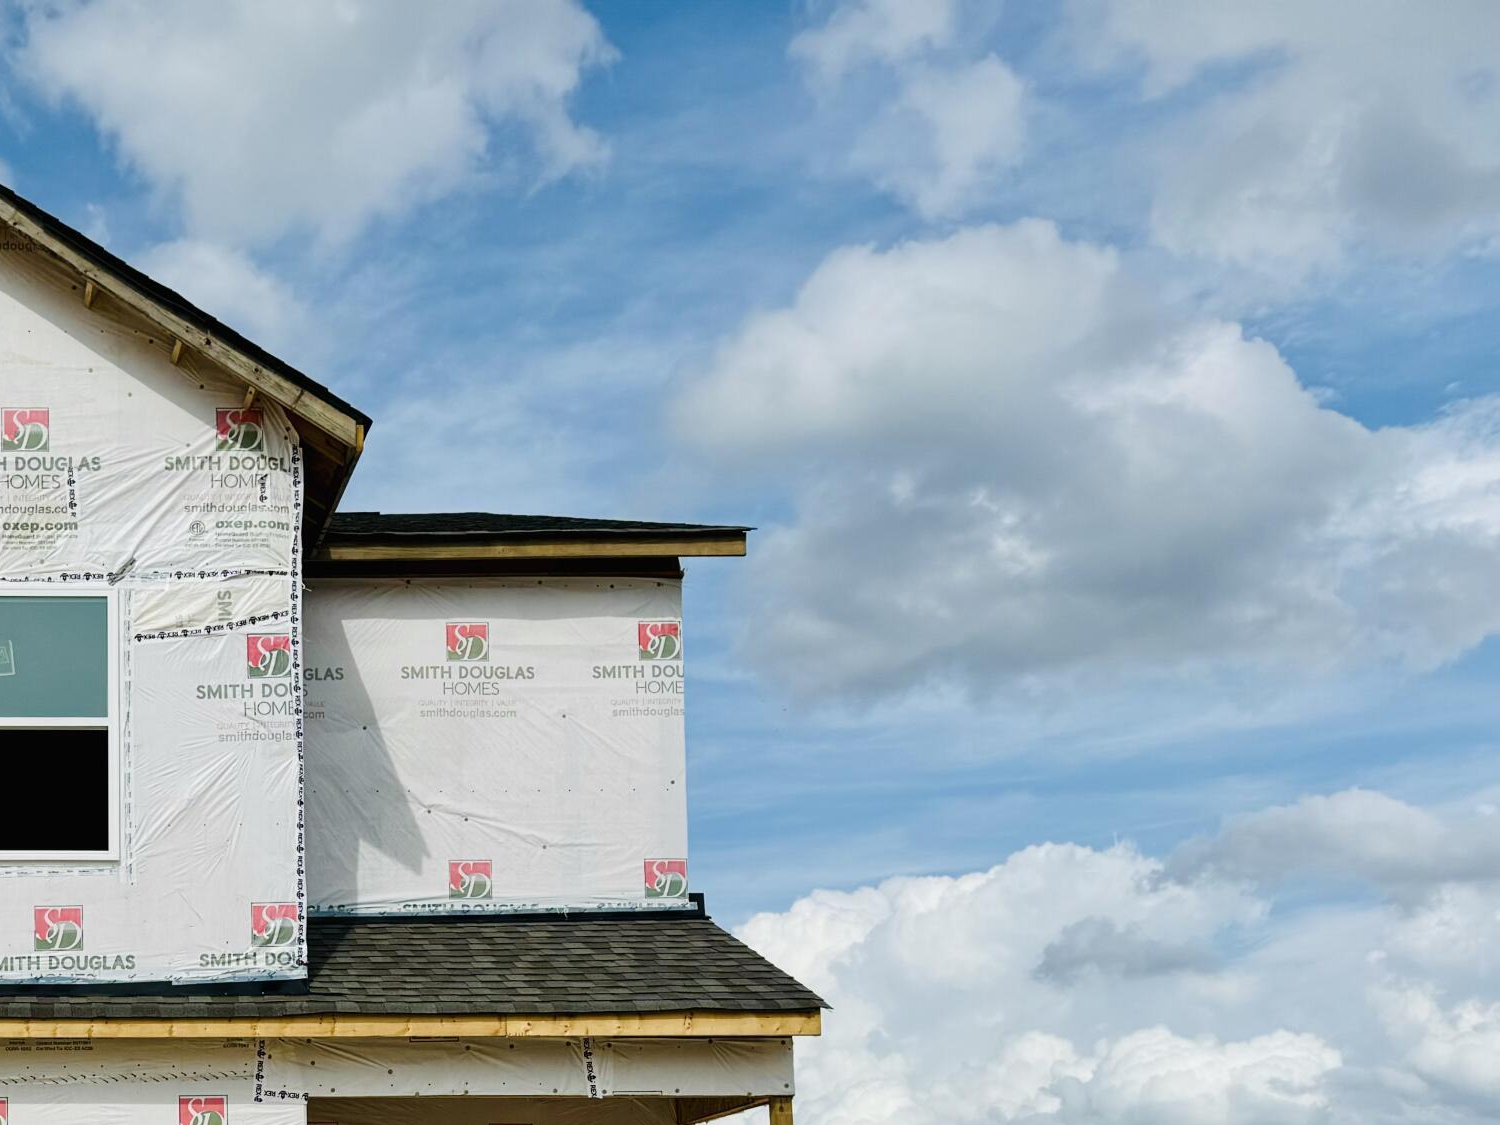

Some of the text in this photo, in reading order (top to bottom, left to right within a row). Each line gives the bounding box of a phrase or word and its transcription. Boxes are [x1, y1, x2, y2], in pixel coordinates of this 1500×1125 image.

[14, 456, 101, 472] DOUGLAS
[164, 456, 221, 471] SMITH
[184, 502, 290, 514] smithdouglas.com
[2, 521, 78, 533] oxep.com
[215, 519, 290, 531] oxep.com
[400, 665, 535, 680] SMITH DOUGLAS
[592, 665, 645, 679] SMITH
[196, 684, 254, 699] SMITH
[442, 681, 500, 696] HOMES
[420, 708, 517, 719] smithdouglas.com
[48, 955, 136, 971] DOUGLAS
[199, 952, 257, 967] SMITH
[586, 1061, 594, 1073] REX
